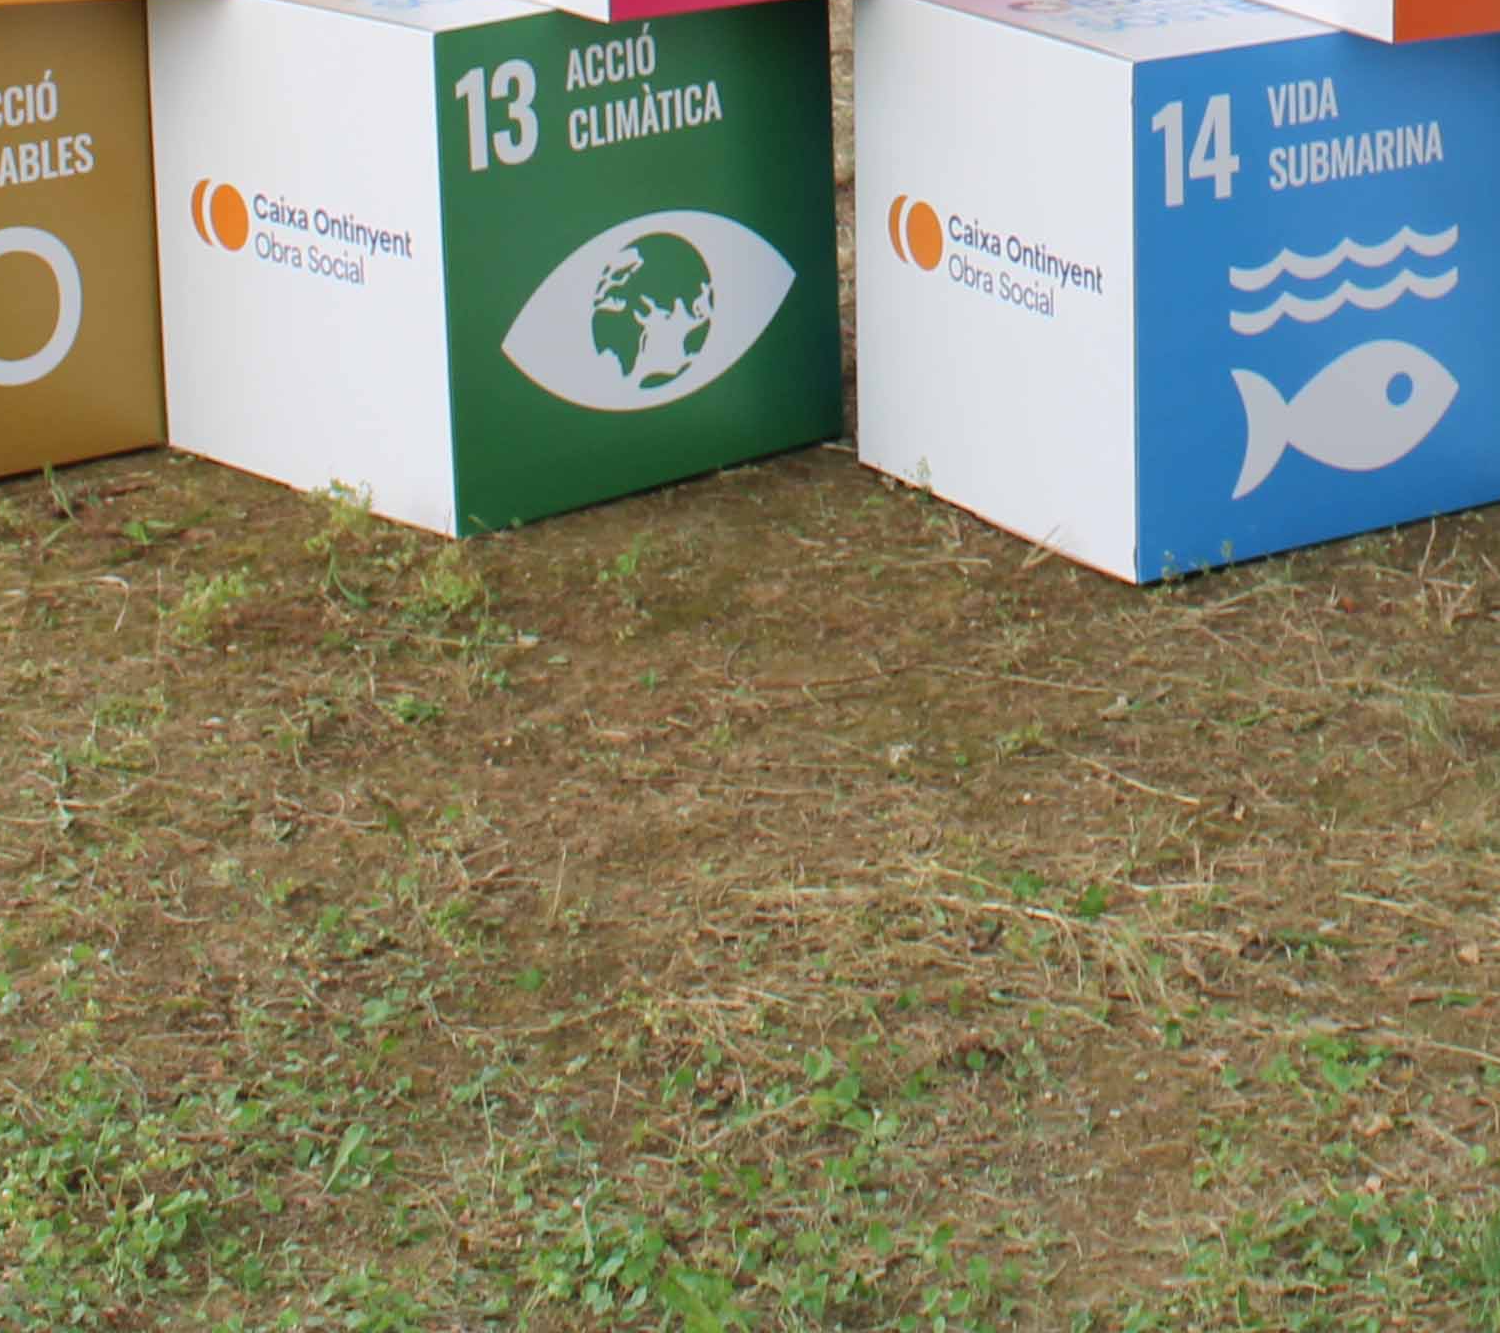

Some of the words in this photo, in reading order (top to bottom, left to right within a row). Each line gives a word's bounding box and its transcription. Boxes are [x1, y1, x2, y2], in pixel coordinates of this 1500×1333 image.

[566, 23, 656, 91] ACCIÓ
[455, 58, 539, 172] 13
[569, 80, 723, 151] CLIMÀTICA
[1267, 77, 1339, 128] VIDA
[1152, 93, 1240, 208] 14
[1269, 121, 1444, 191] SUBMARINA
[253, 193, 309, 231] Caixa
[314, 209, 412, 260] Ontinyent
[255, 231, 303, 269] Obra
[308, 245, 365, 286] Social
[948, 215, 1001, 257] Caixa
[1006, 235, 1103, 295] Ontinyent
[948, 253, 994, 294] Obra
[999, 271, 1055, 318] Social
